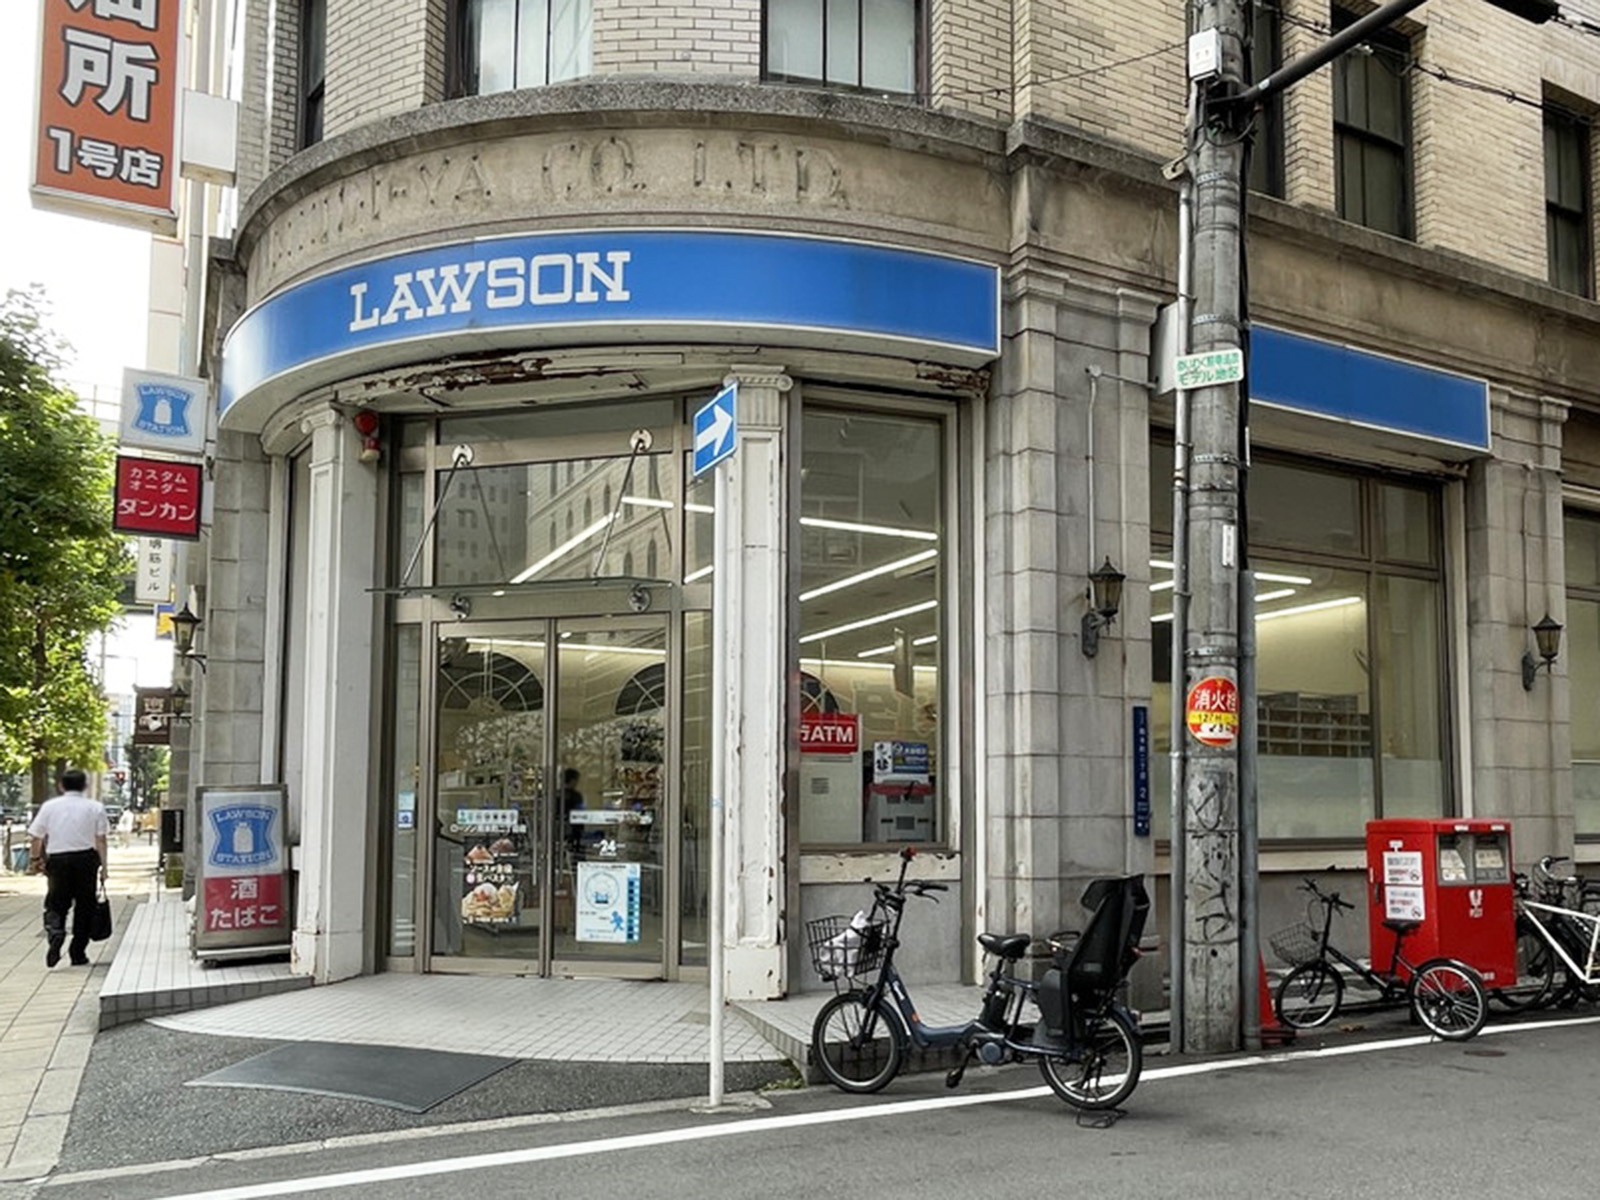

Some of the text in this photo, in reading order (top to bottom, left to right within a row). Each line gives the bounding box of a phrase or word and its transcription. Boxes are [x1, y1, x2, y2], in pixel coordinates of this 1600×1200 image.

[47, 127, 164, 189] 1号店
[350, 251, 632, 332] LAWSON
[140, 386, 187, 401] LAWSON
[130, 467, 187, 484] カスタム
[129, 480, 189, 495] オーダー
[118, 498, 196, 520] ダンカン
[215, 809, 272, 822] LAWSON
[599, 839, 617, 853] 24
[214, 851, 273, 864] STATION
[230, 878, 258, 900] 酒
[210, 904, 279, 929] たばこ
